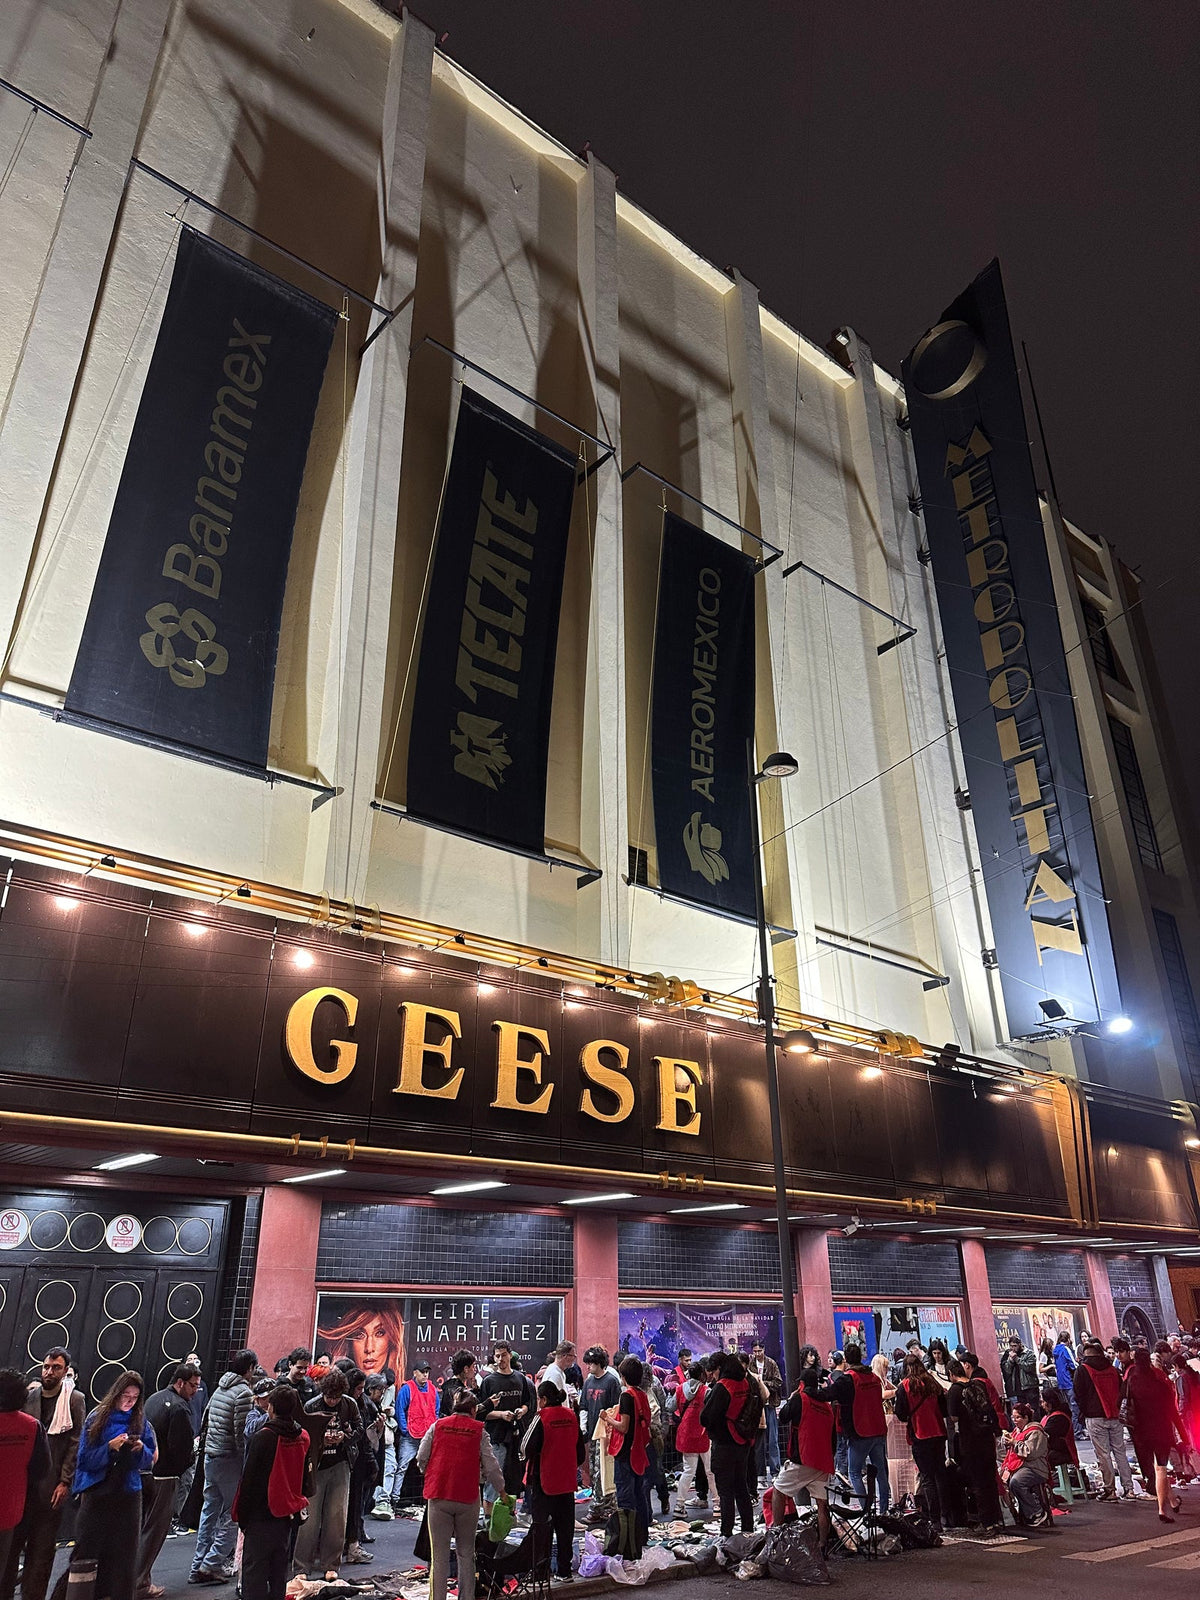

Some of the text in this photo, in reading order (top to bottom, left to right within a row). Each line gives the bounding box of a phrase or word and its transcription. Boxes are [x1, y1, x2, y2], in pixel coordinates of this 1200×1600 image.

[162, 318, 273, 600] Banamex
[455, 458, 541, 704] TECATE
[690, 567, 722, 804] AEROMEXICO
[946, 424, 1082, 965] METROPOLITAN
[285, 986, 703, 1136] GEESE
[416, 1320, 546, 1342] MARTÍNEZ
[417, 1302, 490, 1320] LEIRE
